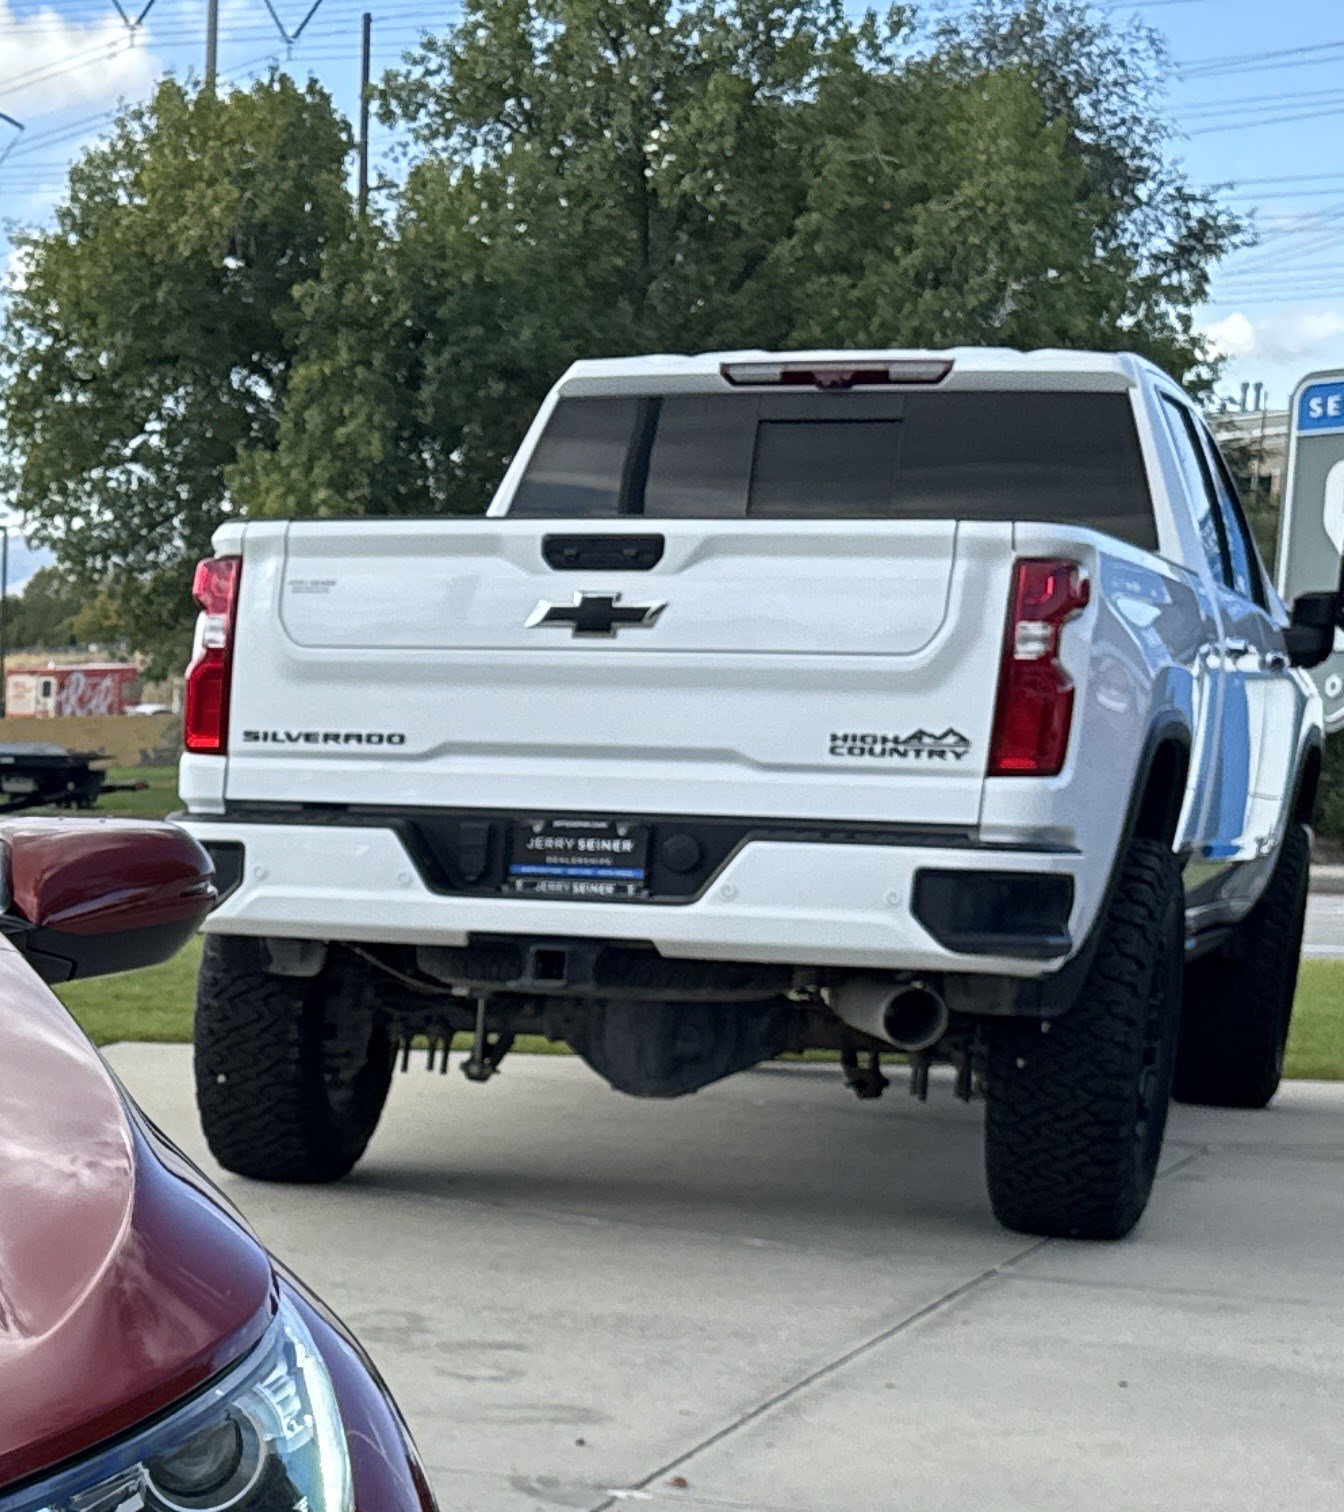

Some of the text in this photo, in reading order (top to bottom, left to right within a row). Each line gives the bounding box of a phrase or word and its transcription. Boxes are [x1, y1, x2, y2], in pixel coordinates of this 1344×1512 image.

[242, 730, 406, 745] SILVERADO
[830, 732, 901, 745] HIGH
[829, 746, 968, 760] COUNTRY
[527, 836, 635, 852] JERRY SEINER
